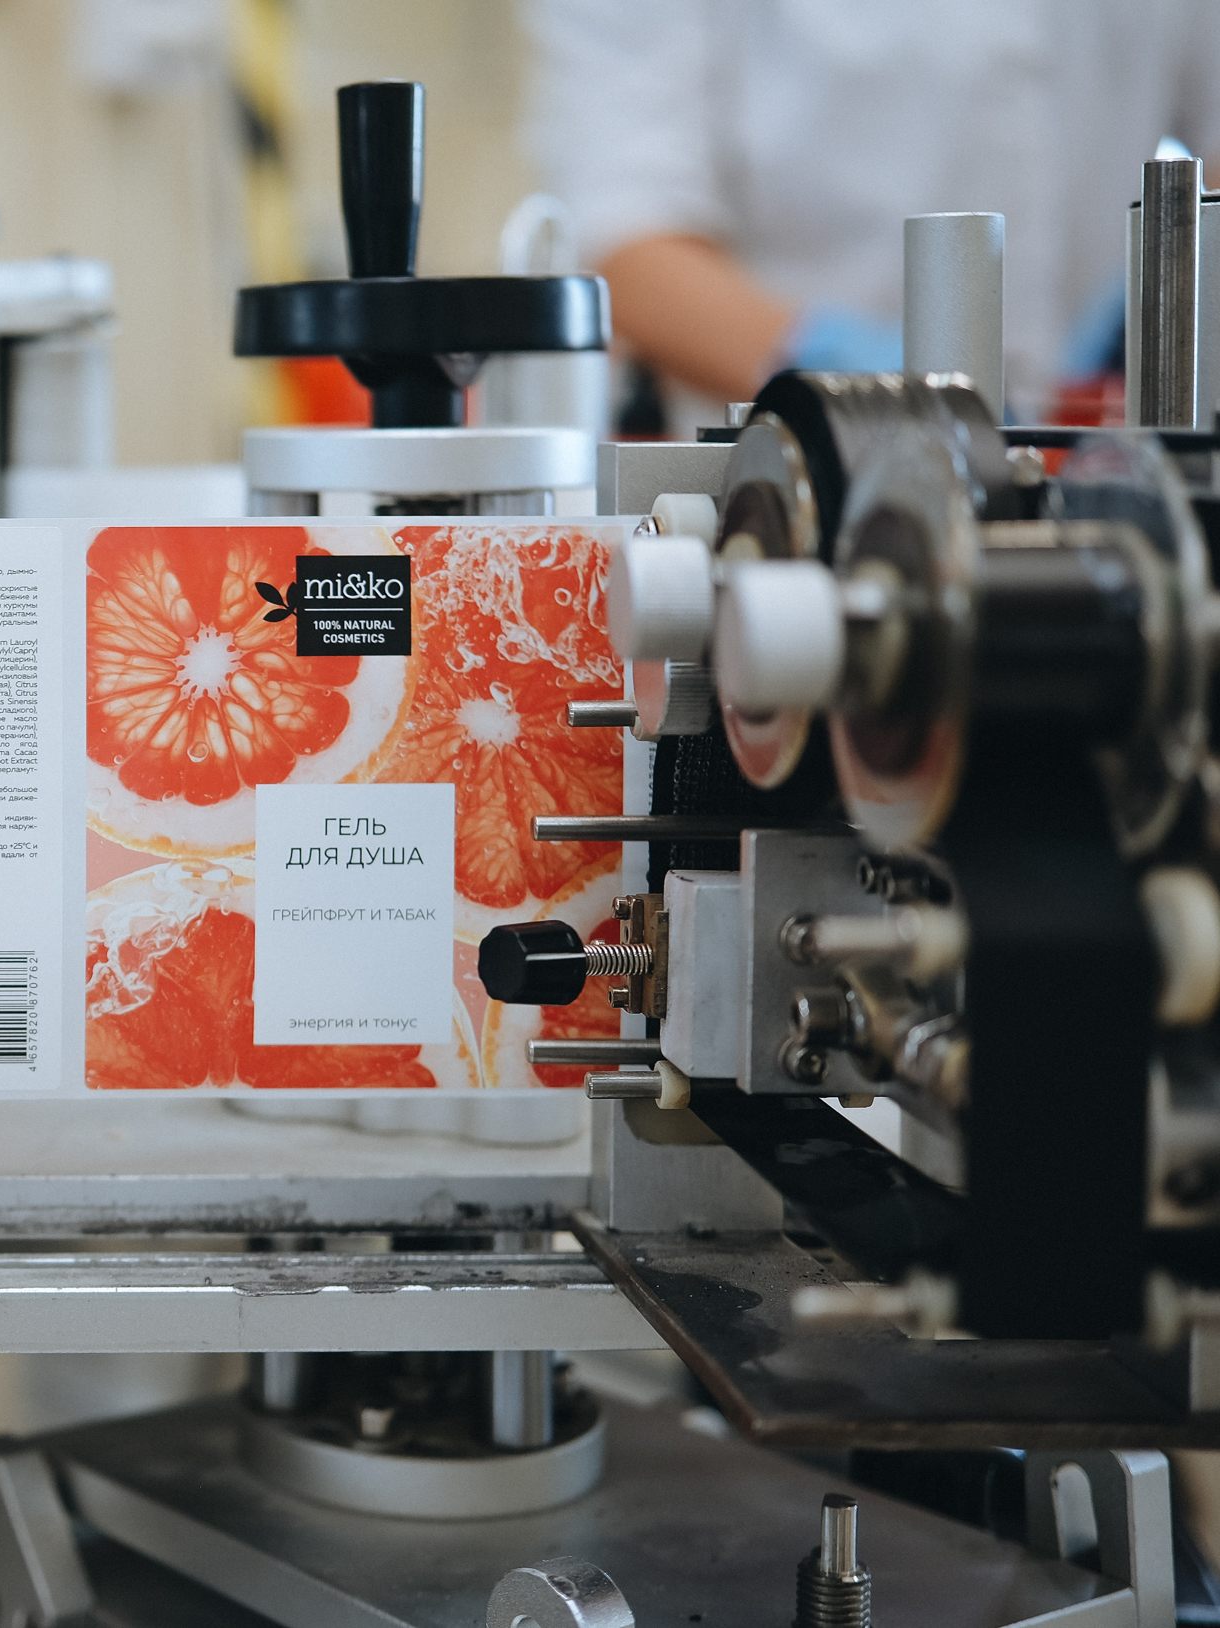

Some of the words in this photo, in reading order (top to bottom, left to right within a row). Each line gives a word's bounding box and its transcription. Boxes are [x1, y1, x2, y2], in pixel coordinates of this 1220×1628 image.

[304, 571, 404, 599] mi&ko
[313, 620, 341, 630] 100%
[344, 620, 395, 630] NATURAL
[10, 638, 38, 647] Lauroyl
[323, 633, 385, 643] COSMETICS
[6, 723, 38, 732] пачули),
[324, 818, 386, 835] ГЕЛЬ
[286, 848, 338, 869] ДЛЯ
[346, 847, 424, 869] ДУША
[272, 907, 365, 921] ГРЕЙПФРУТ
[371, 909, 381, 920] И
[386, 909, 436, 920] ТАБАК
[29, 957, 38, 1005] 870762
[289, 1019, 353, 1031] энергия
[359, 1019, 368, 1027] и
[374, 1018, 417, 1030] тонус
